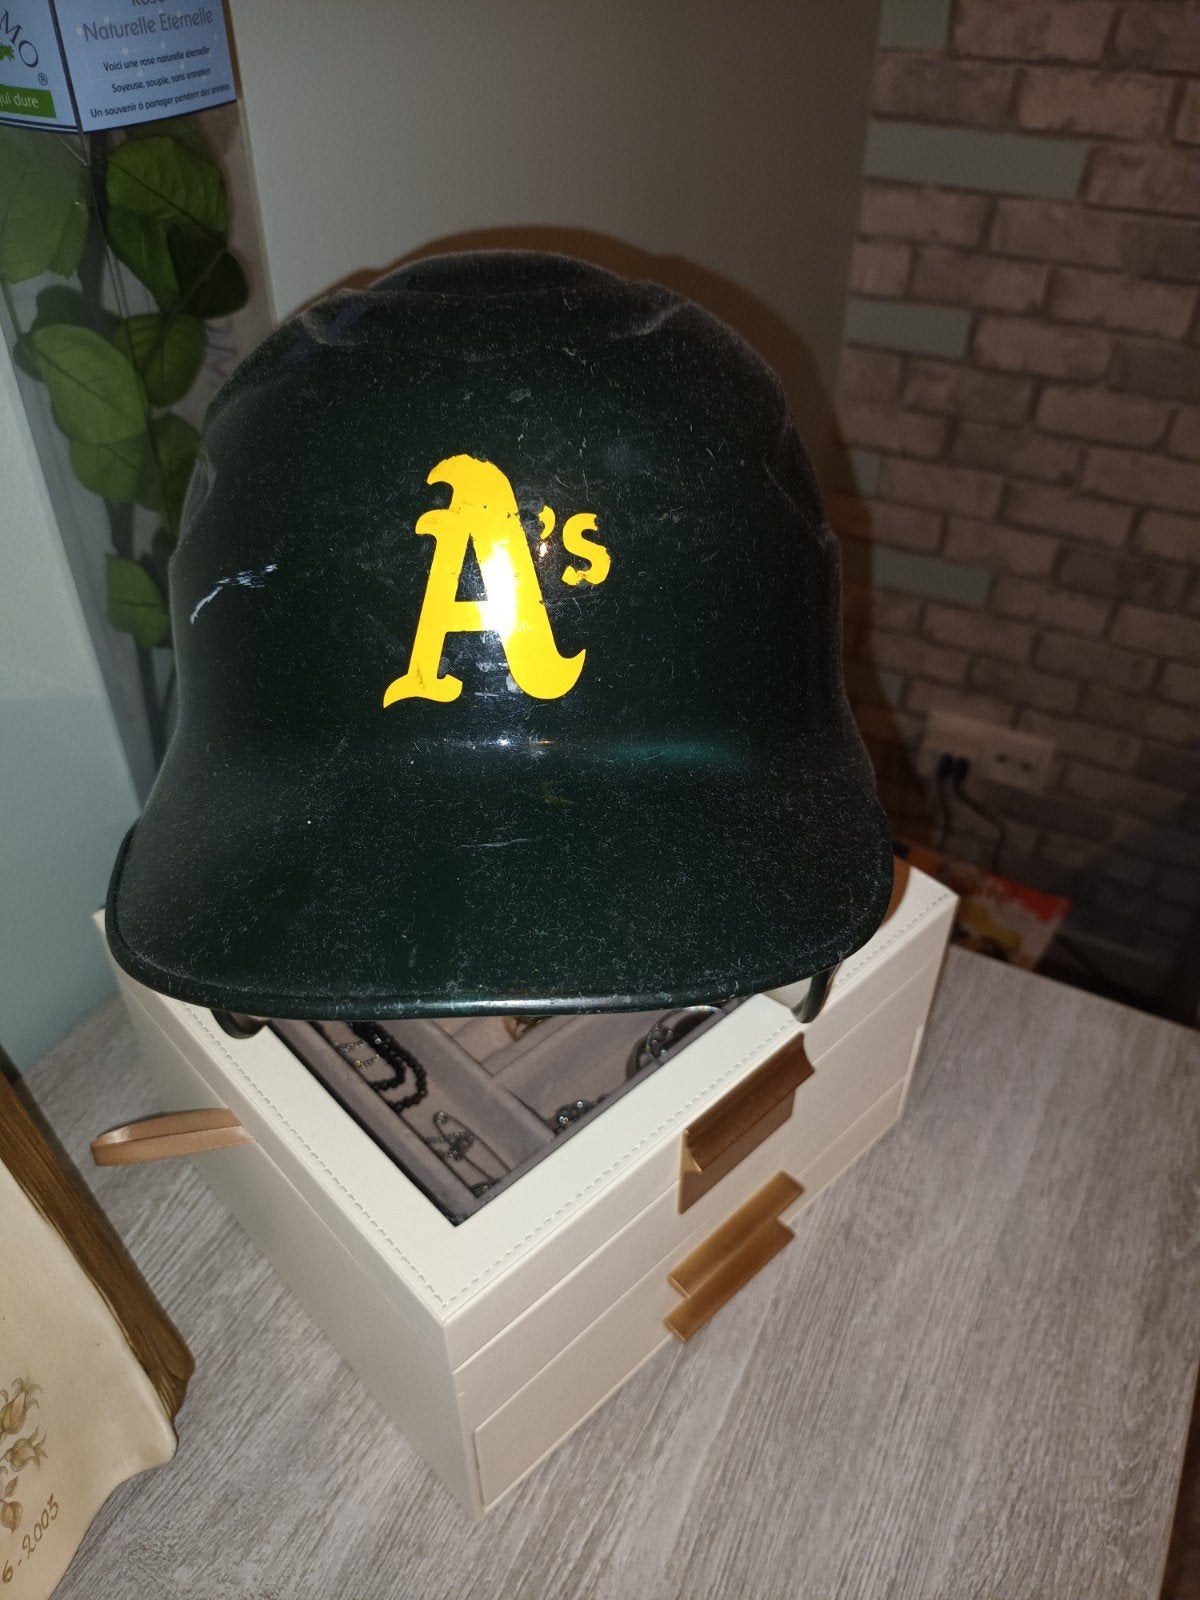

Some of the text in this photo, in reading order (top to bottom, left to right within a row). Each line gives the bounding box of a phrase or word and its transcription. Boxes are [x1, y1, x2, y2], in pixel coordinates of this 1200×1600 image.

[82, 7, 213, 41] Naturelle Eternelle
[103, 62, 122, 71] Voici
[124, 60, 138, 69] une
[140, 57, 155, 66] rose
[156, 52, 184, 63] naturelle
[112, 81, 145, 94] Soyeuse,
[146, 76, 170, 89] souple,
[171, 73, 186, 83] sans
[13, 92, 40, 108] dure
[91, 108, 103, 118] Un
[105, 103, 137, 116] souvenir
[138, 101, 144, 110] à
[145, 97, 173, 111] partager
[174, 90, 199, 104] pendant
[200, 87, 210, 96] des
